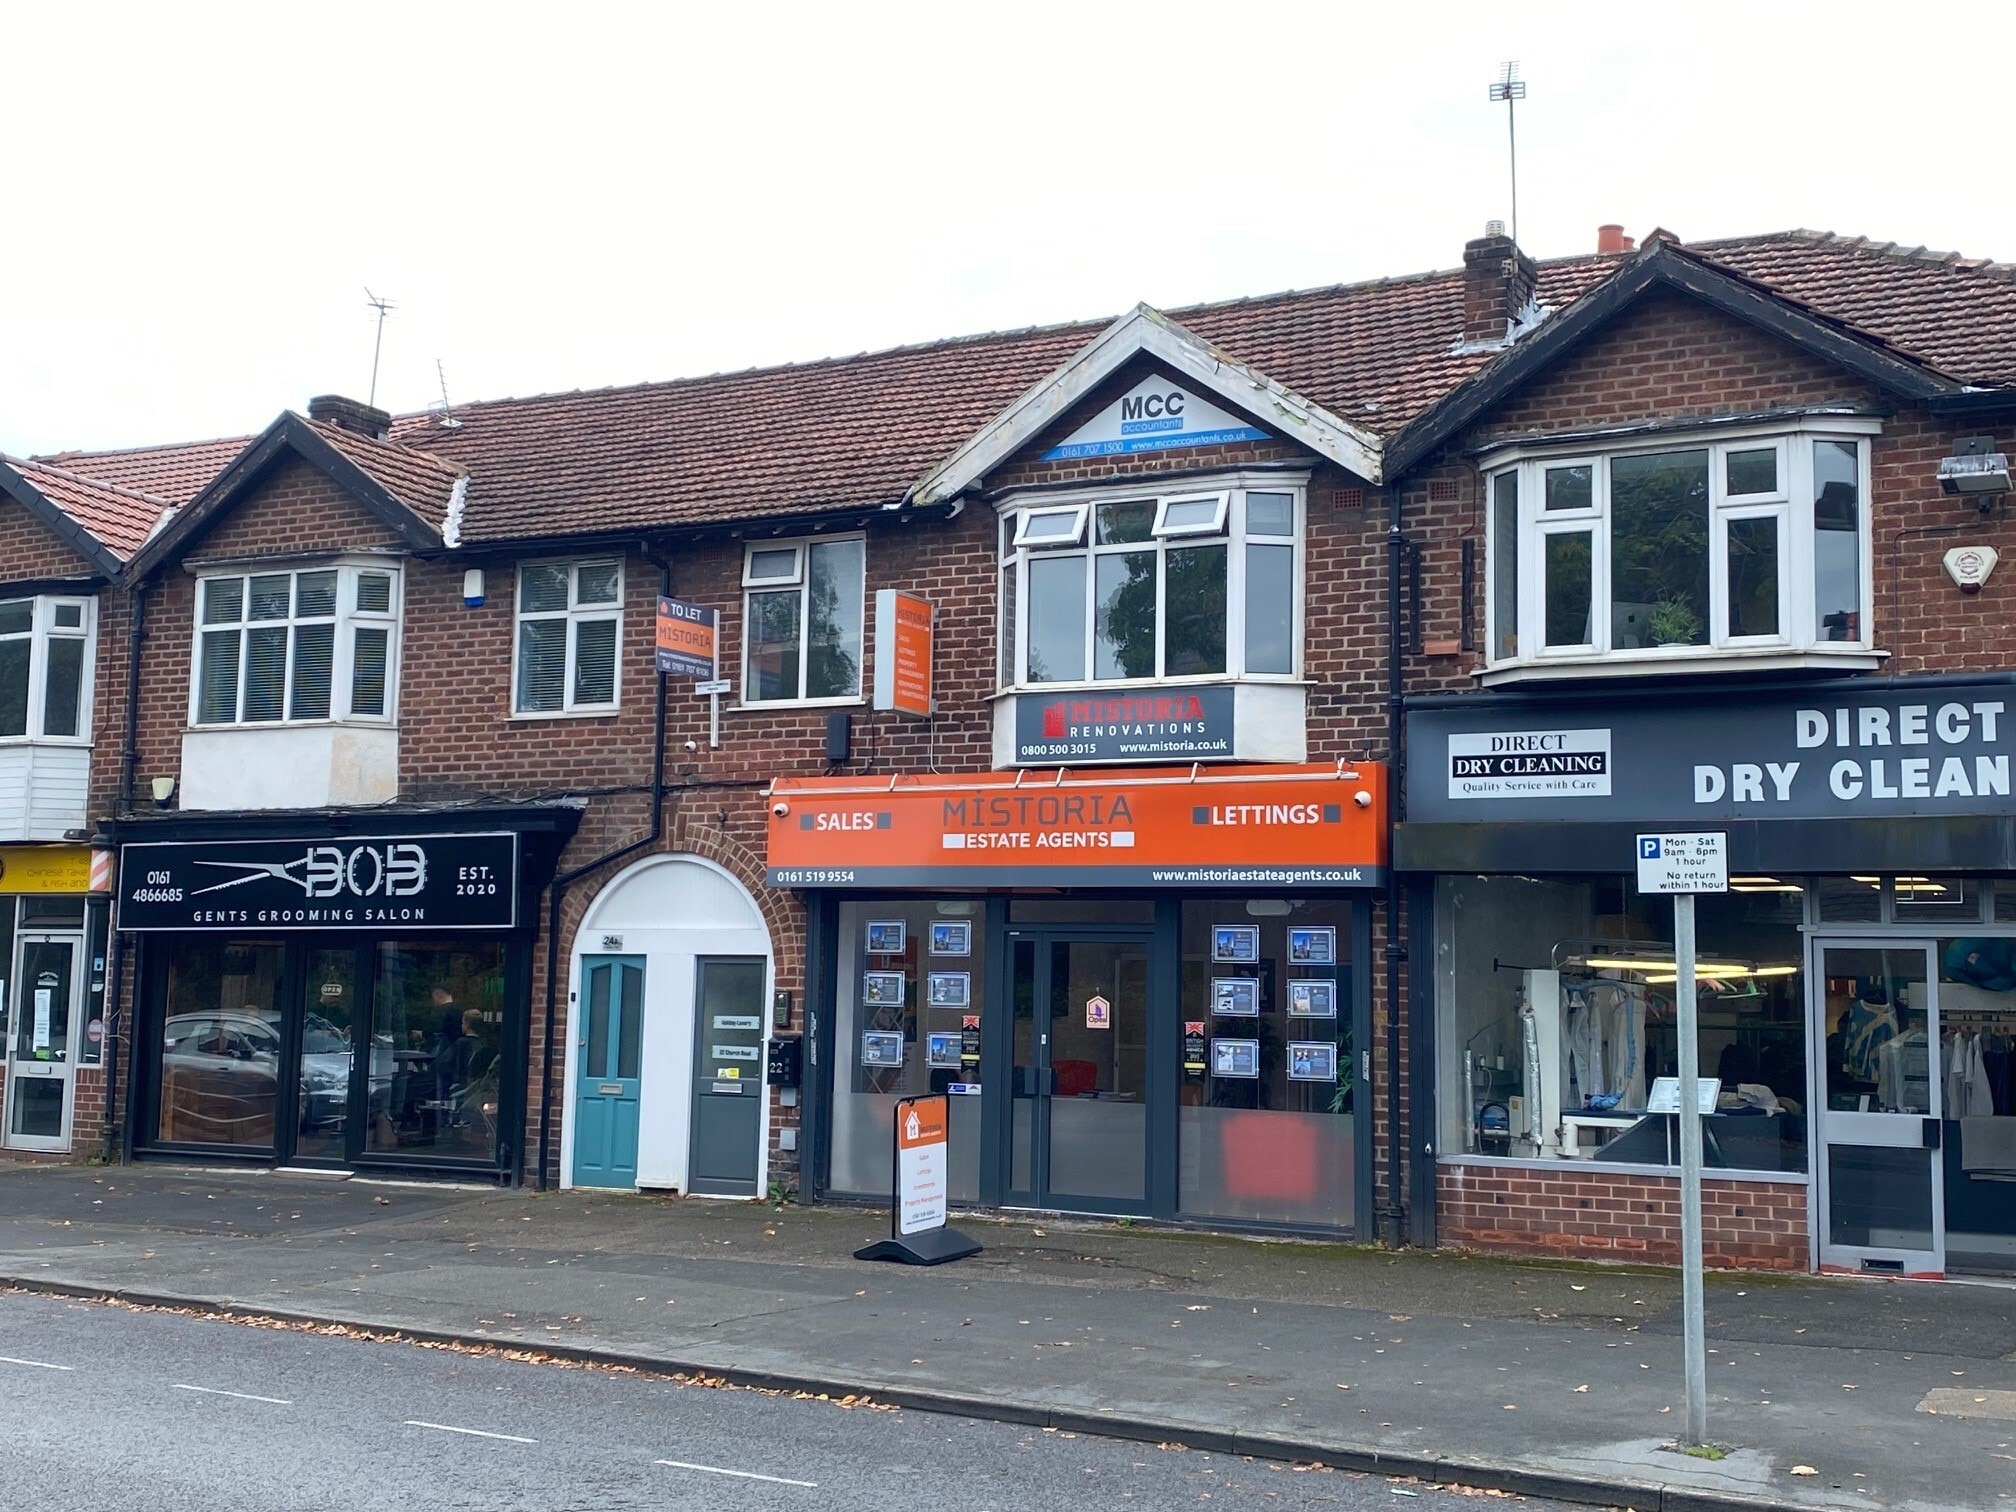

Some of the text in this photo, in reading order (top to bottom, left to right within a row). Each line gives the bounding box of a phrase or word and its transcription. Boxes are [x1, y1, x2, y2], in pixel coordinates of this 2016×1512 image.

[1121, 392, 1184, 419] MCC
[1122, 418, 1182, 433] accountants
[1062, 432, 1246, 458] 0161 707 1500 www.mccaccountants.co.uk
[671, 603, 702, 620] TO LET
[659, 622, 712, 649] MISTORIA
[1070, 696, 1205, 723] MISTORIA
[1070, 721, 1206, 738] RENOVATIONS
[1796, 701, 2005, 748] DIRECT
[1021, 738, 1227, 756] 0800 500 3015 www.mistoria.co.uk
[1491, 734, 1568, 752] DIRECT
[1456, 755, 1602, 775] DRY CLEANING
[1462, 779, 1597, 793] Quality Service with Care
[1694, 761, 1801, 803] DRY
[942, 790, 1134, 827] MISTORIA
[1212, 804, 1320, 826] LETTINGS
[816, 812, 874, 831] SALES
[966, 831, 1109, 849] ESTATE AGENTS
[1644, 840, 1657, 857] P
[1665, 838, 1687, 847] Mon
[1698, 837, 1715, 846] Sat
[1664, 848, 1685, 856] 9am
[1696, 847, 1718, 857] 6pm
[1684, 857, 1706, 866] hour
[147, 870, 170, 885] 0161
[306, 844, 429, 898] BOB
[459, 866, 495, 880] EST.
[777, 867, 1362, 884] 0161 519 9554 www.mistoriaestateagents.co.uk
[1667, 871, 1716, 880] No return
[456, 884, 497, 896] 2020
[1660, 881, 1690, 890] within
[1702, 880, 1724, 889] hour
[132, 888, 183, 902] 4866685
[193, 908, 425, 922] GENTS GROOMING SALON
[1088, 1016, 1107, 1024] Open
[769, 1062, 783, 1073] 22
